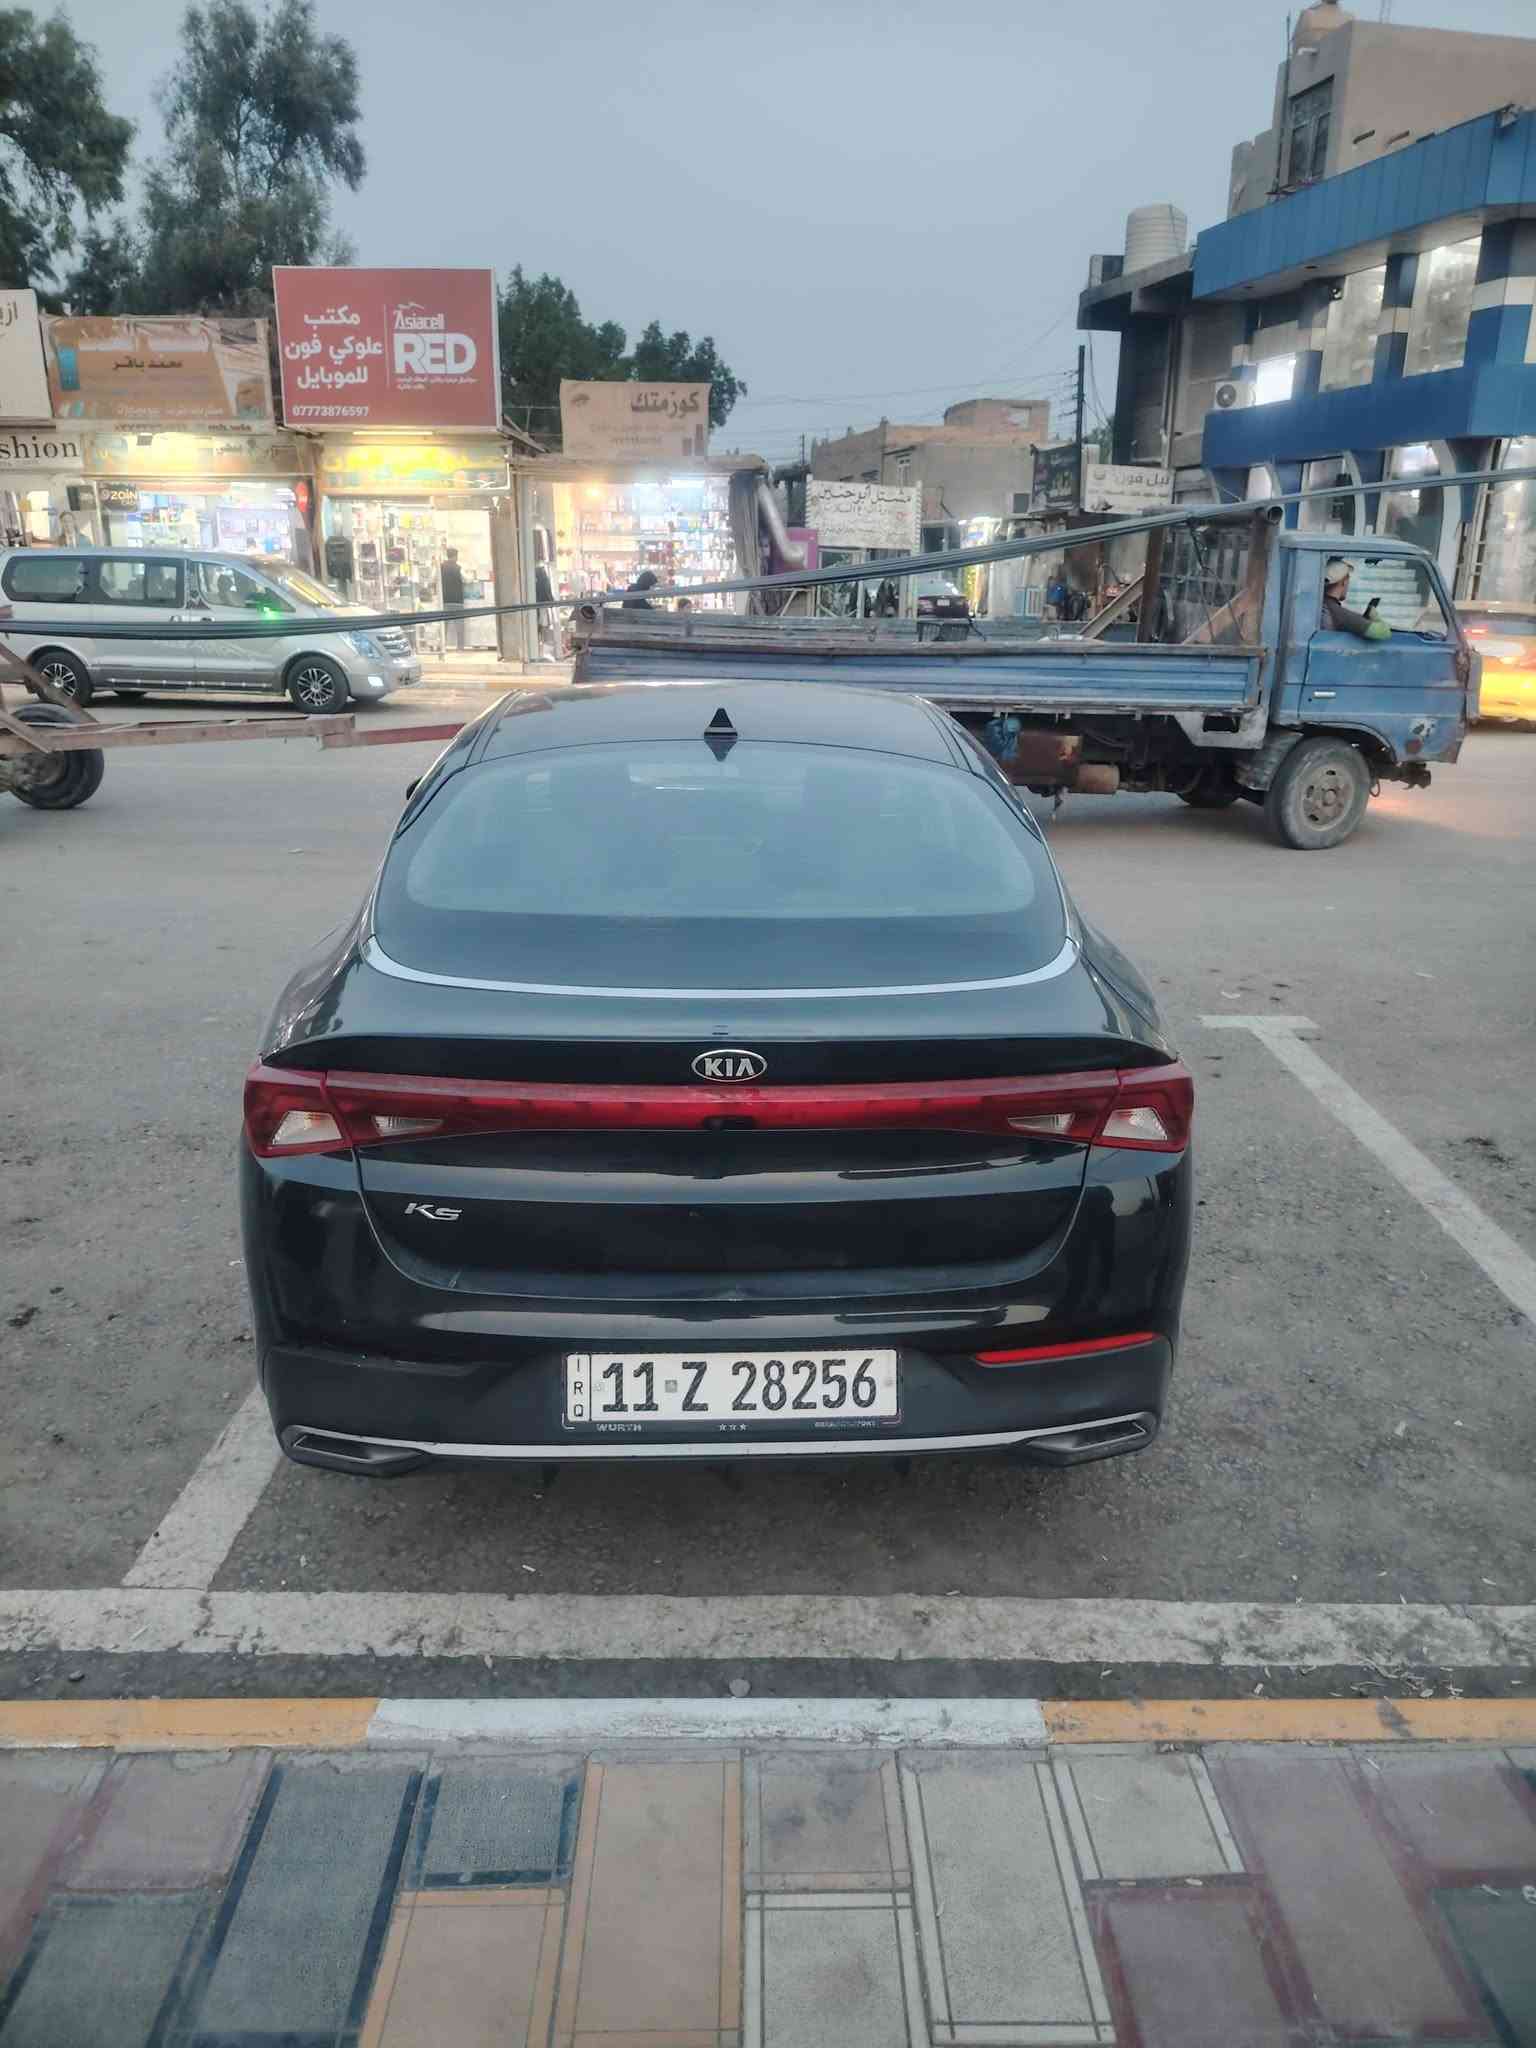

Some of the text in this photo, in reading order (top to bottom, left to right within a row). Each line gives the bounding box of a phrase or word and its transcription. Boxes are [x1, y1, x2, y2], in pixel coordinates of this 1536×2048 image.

[303, 305, 361, 330] مكتب
[393, 310, 445, 330] Asiacell
[284, 333, 323, 359] فون
[393, 332, 477, 375] RED
[297, 366, 369, 390] للموبايل
[631, 391, 699, 418] كوزمتك
[0, 435, 78, 459] shion
[704, 1057, 756, 1077] KIA
[602, 1358, 878, 1412] 11 Z 28256
